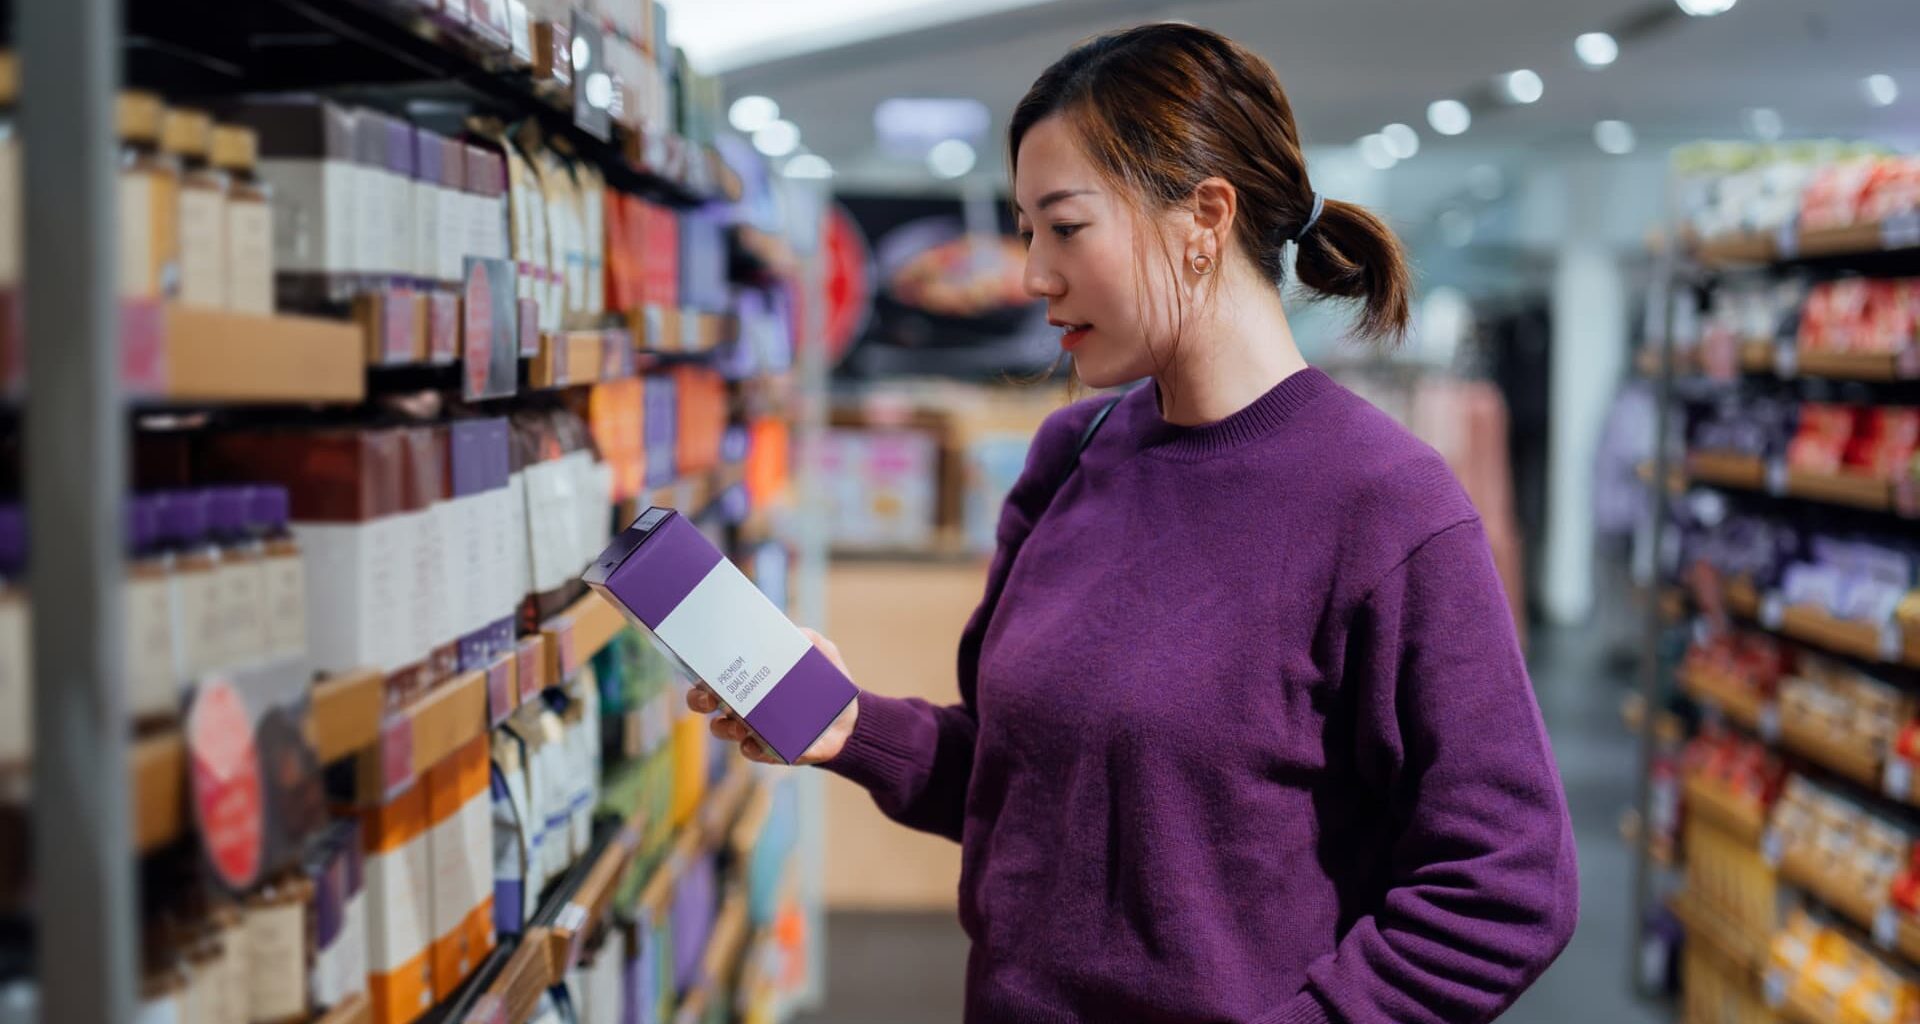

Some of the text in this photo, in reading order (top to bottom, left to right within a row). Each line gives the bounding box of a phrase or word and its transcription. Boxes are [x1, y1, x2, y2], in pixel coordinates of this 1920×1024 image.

[718, 656, 745, 685] PREMIUM
[726, 669, 750, 694] QUALITY
[735, 665, 771, 702] GUARANTEED
